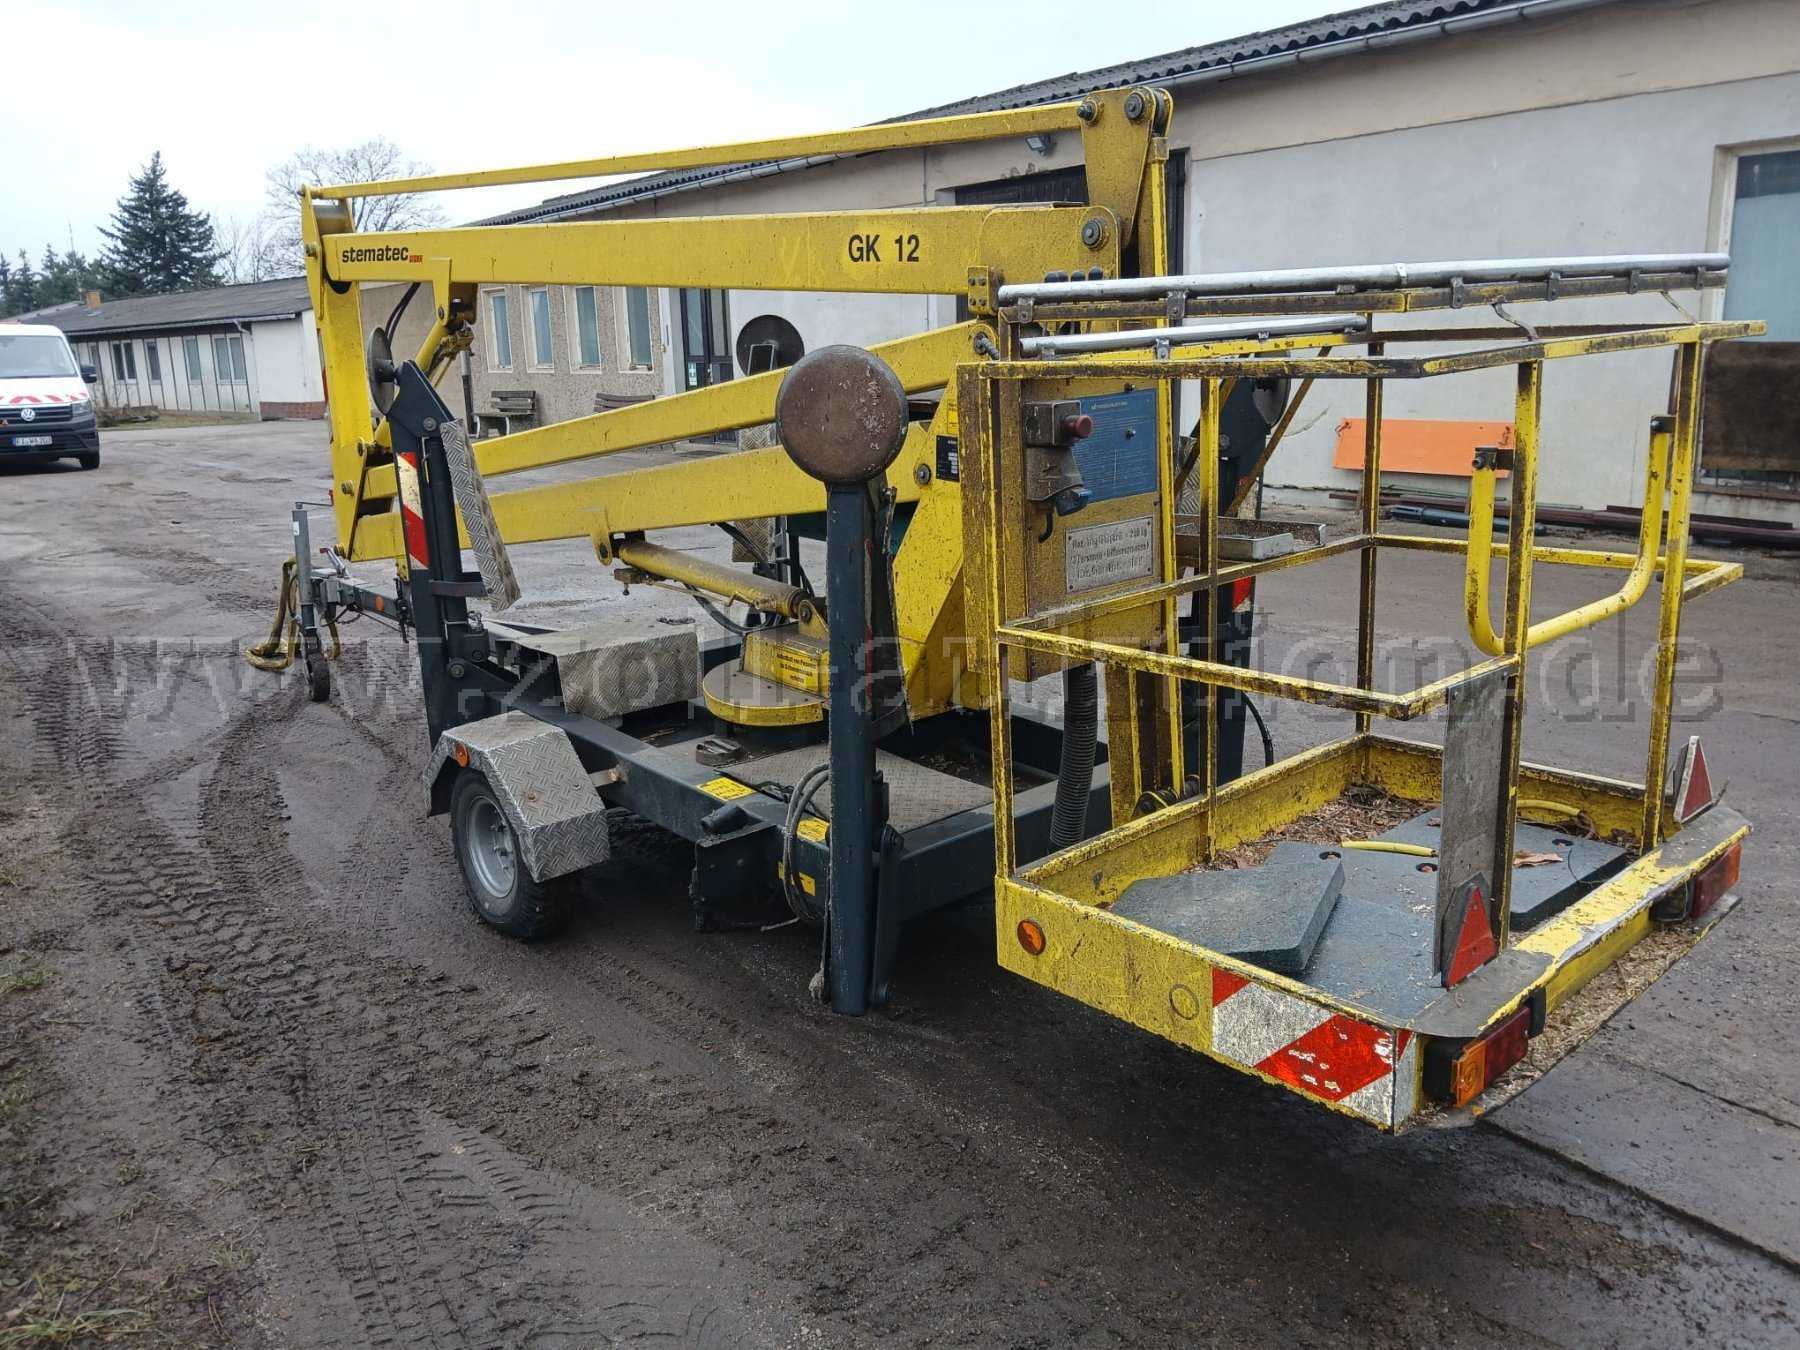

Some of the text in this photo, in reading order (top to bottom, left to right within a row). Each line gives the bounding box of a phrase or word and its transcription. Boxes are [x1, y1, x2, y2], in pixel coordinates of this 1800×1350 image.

[342, 245, 409, 263] stematec
[848, 234, 920, 262] GK 12
